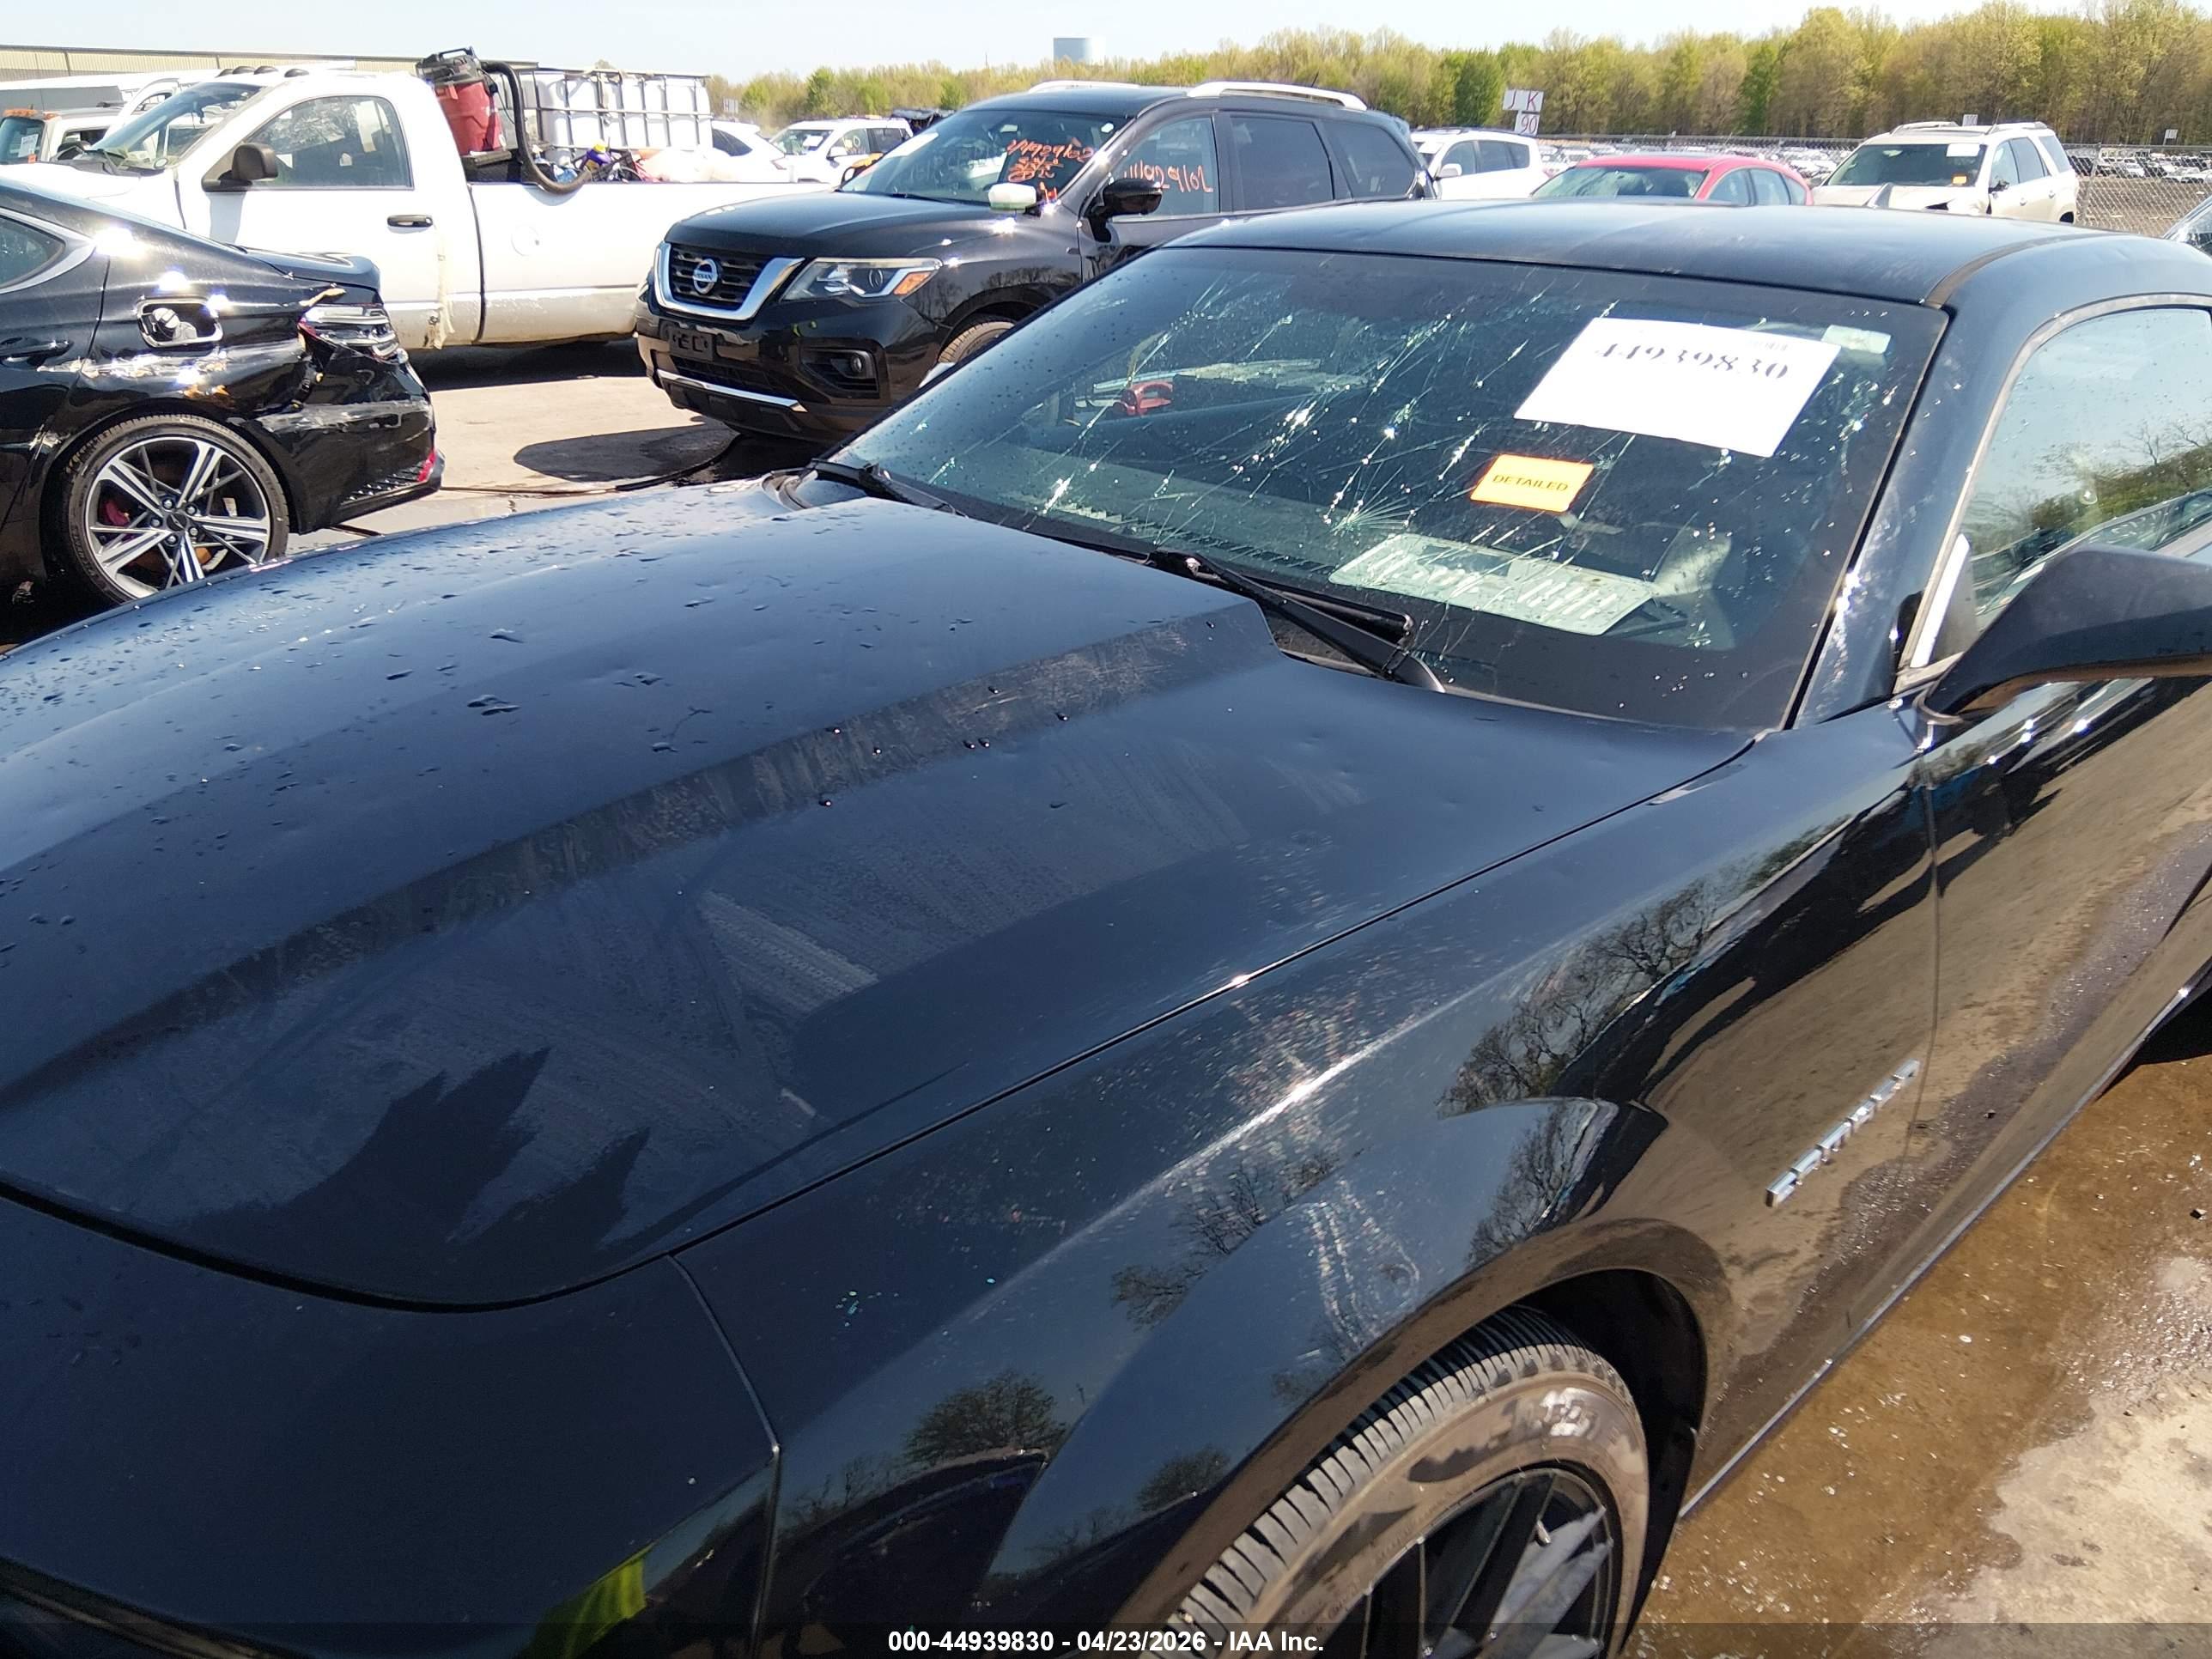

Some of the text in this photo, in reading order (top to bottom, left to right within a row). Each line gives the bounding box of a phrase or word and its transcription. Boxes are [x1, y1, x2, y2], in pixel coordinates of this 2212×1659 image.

[1507, 89, 1539, 112] J K
[1520, 114, 1538, 134] 90
[1594, 342, 1789, 379] 44939830
[1492, 474, 1569, 492] DETAILED
